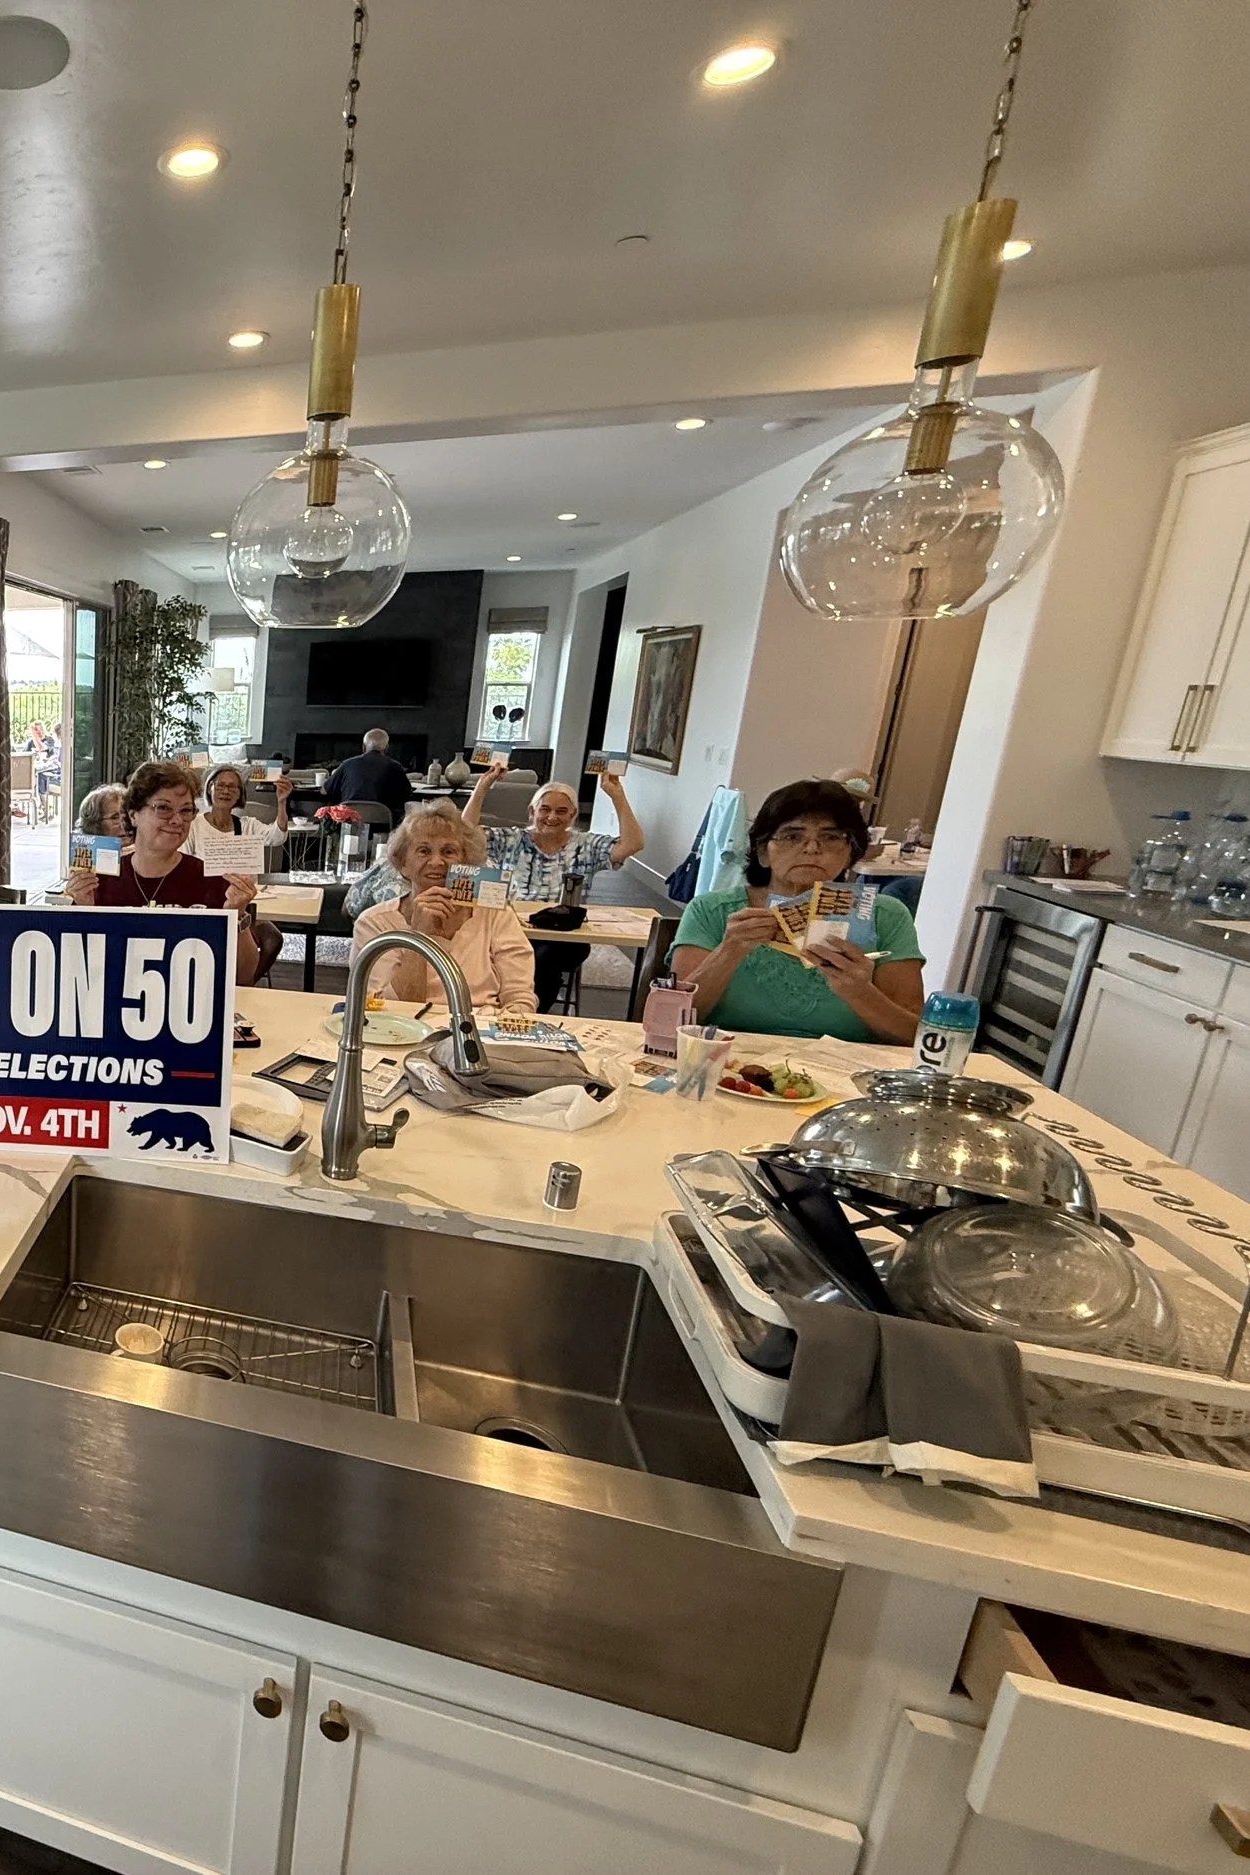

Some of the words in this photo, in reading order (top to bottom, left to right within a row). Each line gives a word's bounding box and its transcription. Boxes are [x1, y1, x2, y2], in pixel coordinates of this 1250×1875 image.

[72, 835, 96, 845] VOTING
[450, 864, 480, 876] VOTING
[857, 886, 876, 920] VOTING
[10, 930, 107, 1039] ON
[121, 938, 215, 1044] 50
[40, 1109, 100, 1139] 4TH
